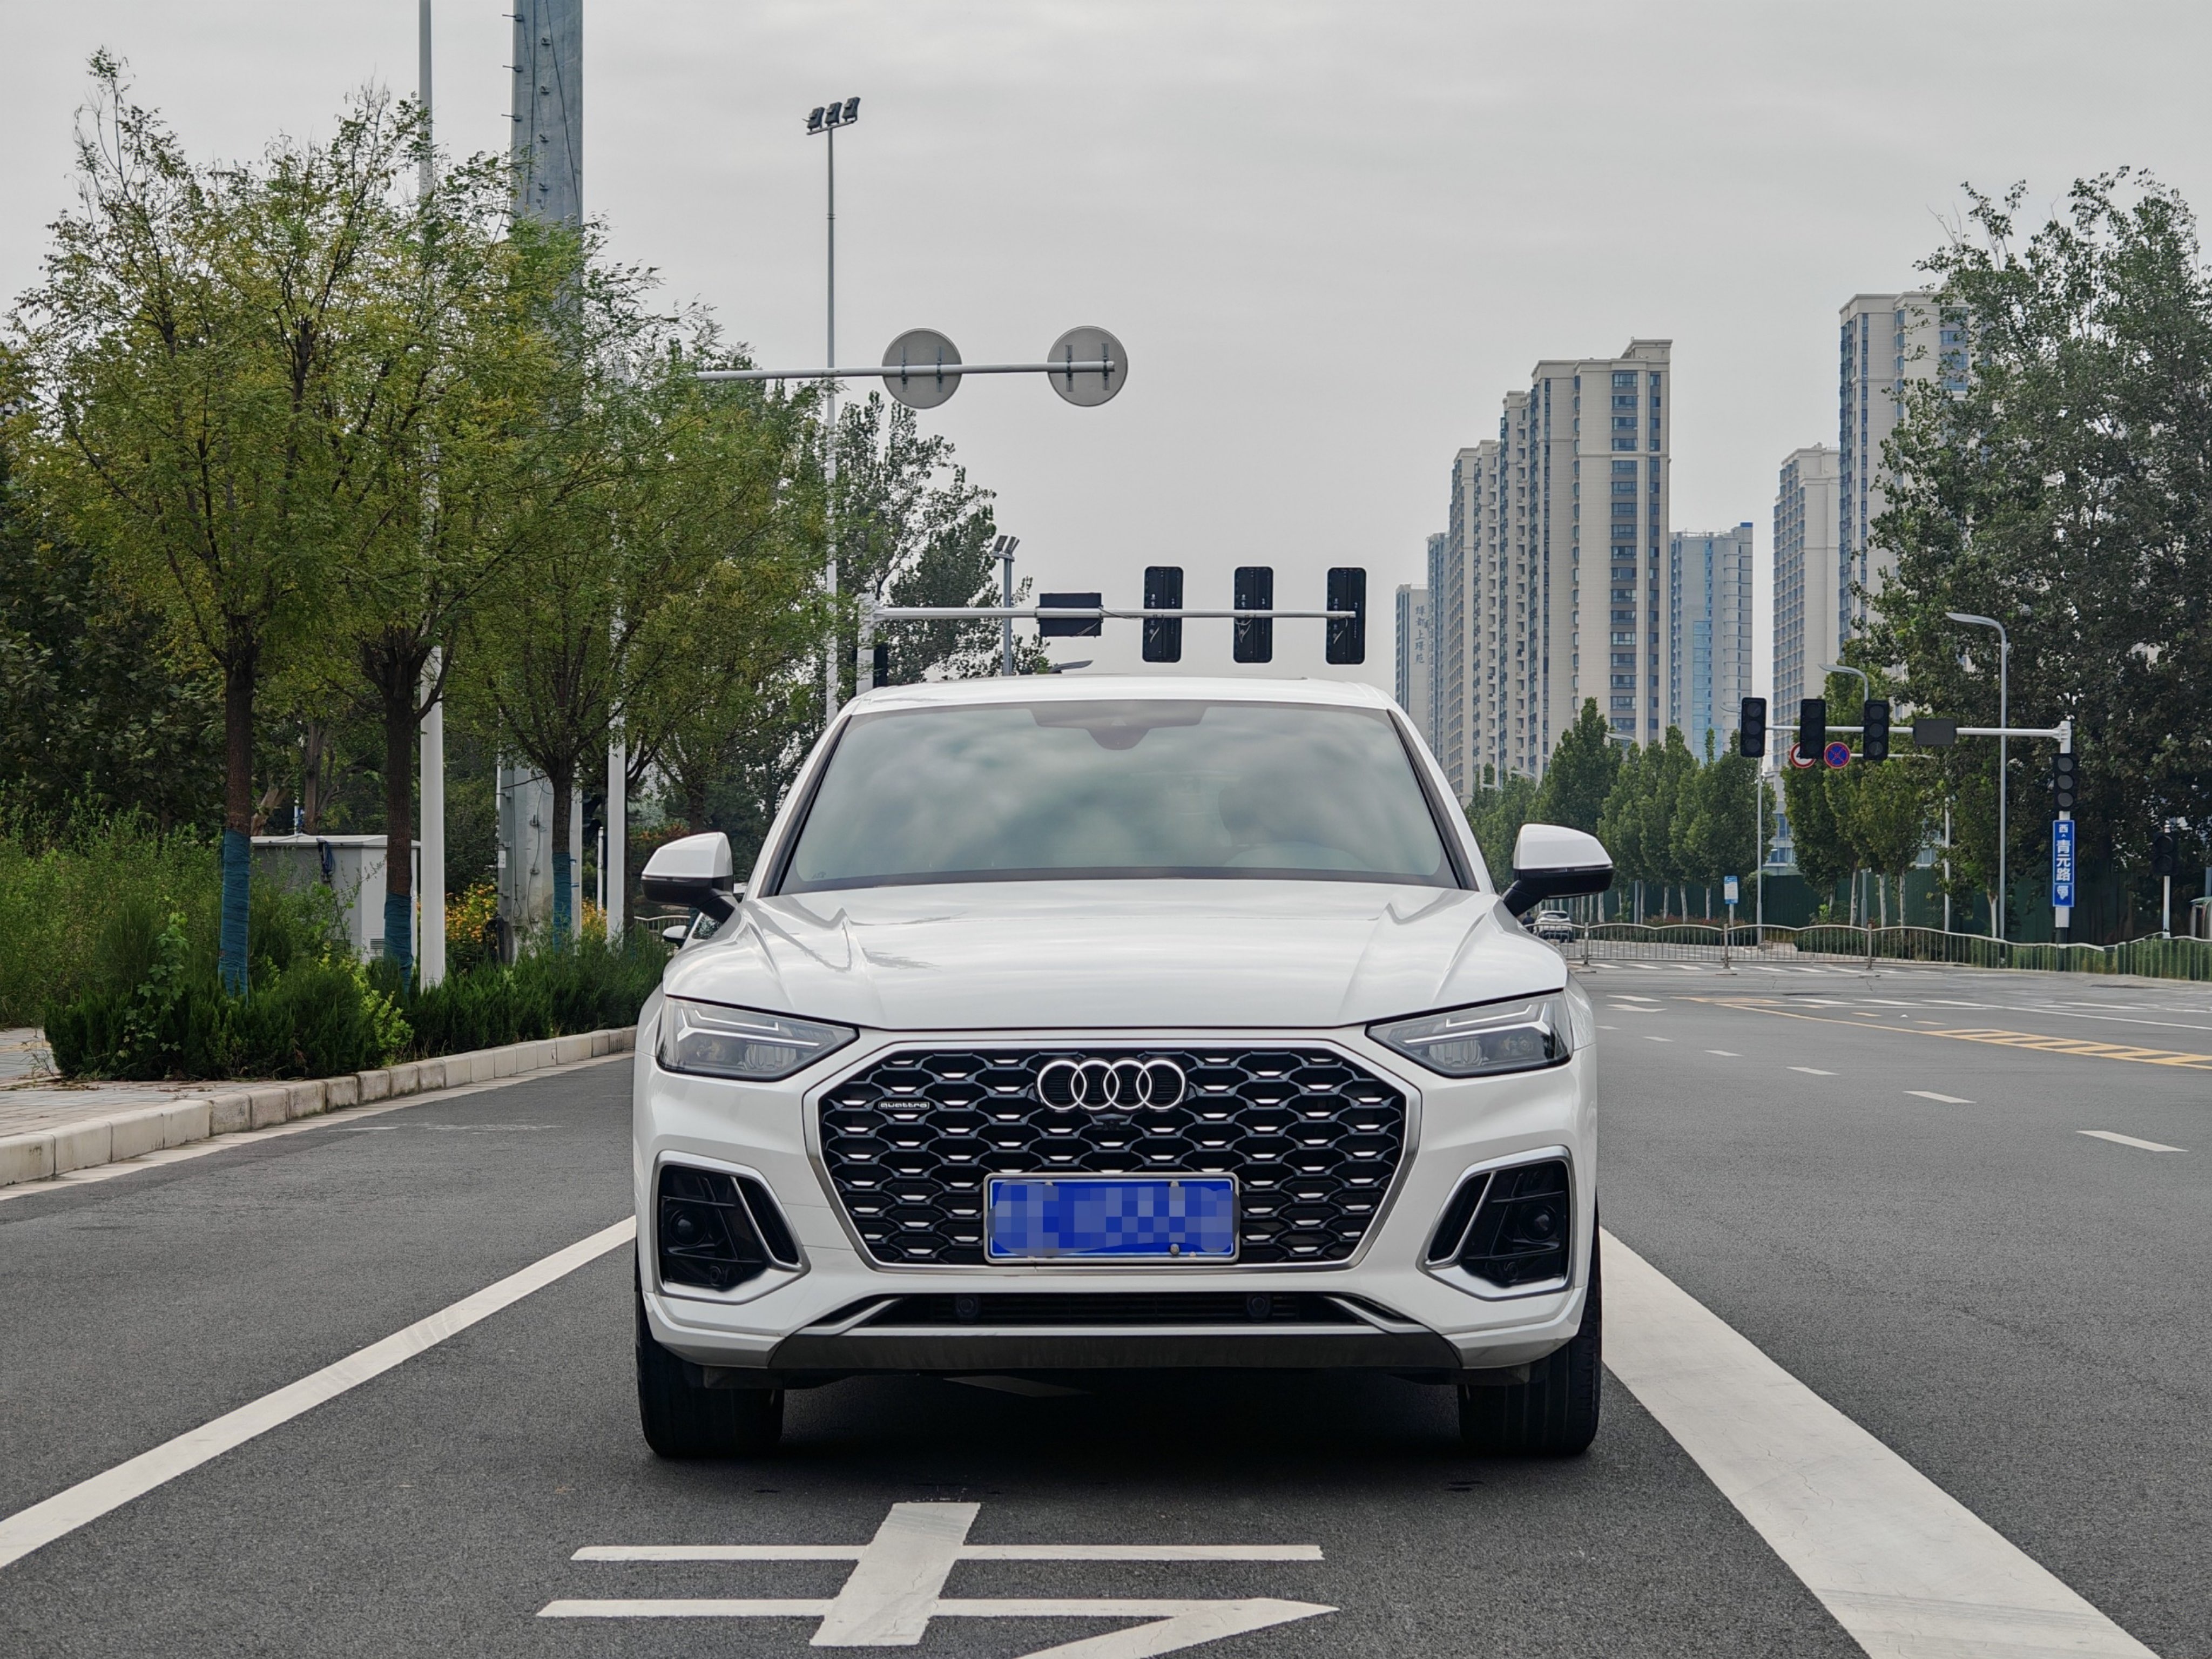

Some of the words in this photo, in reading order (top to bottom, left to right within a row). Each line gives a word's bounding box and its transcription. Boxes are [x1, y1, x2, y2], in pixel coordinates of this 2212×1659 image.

[2059, 824, 2069, 833] 西
[2056, 839, 2071, 881] 青元路
